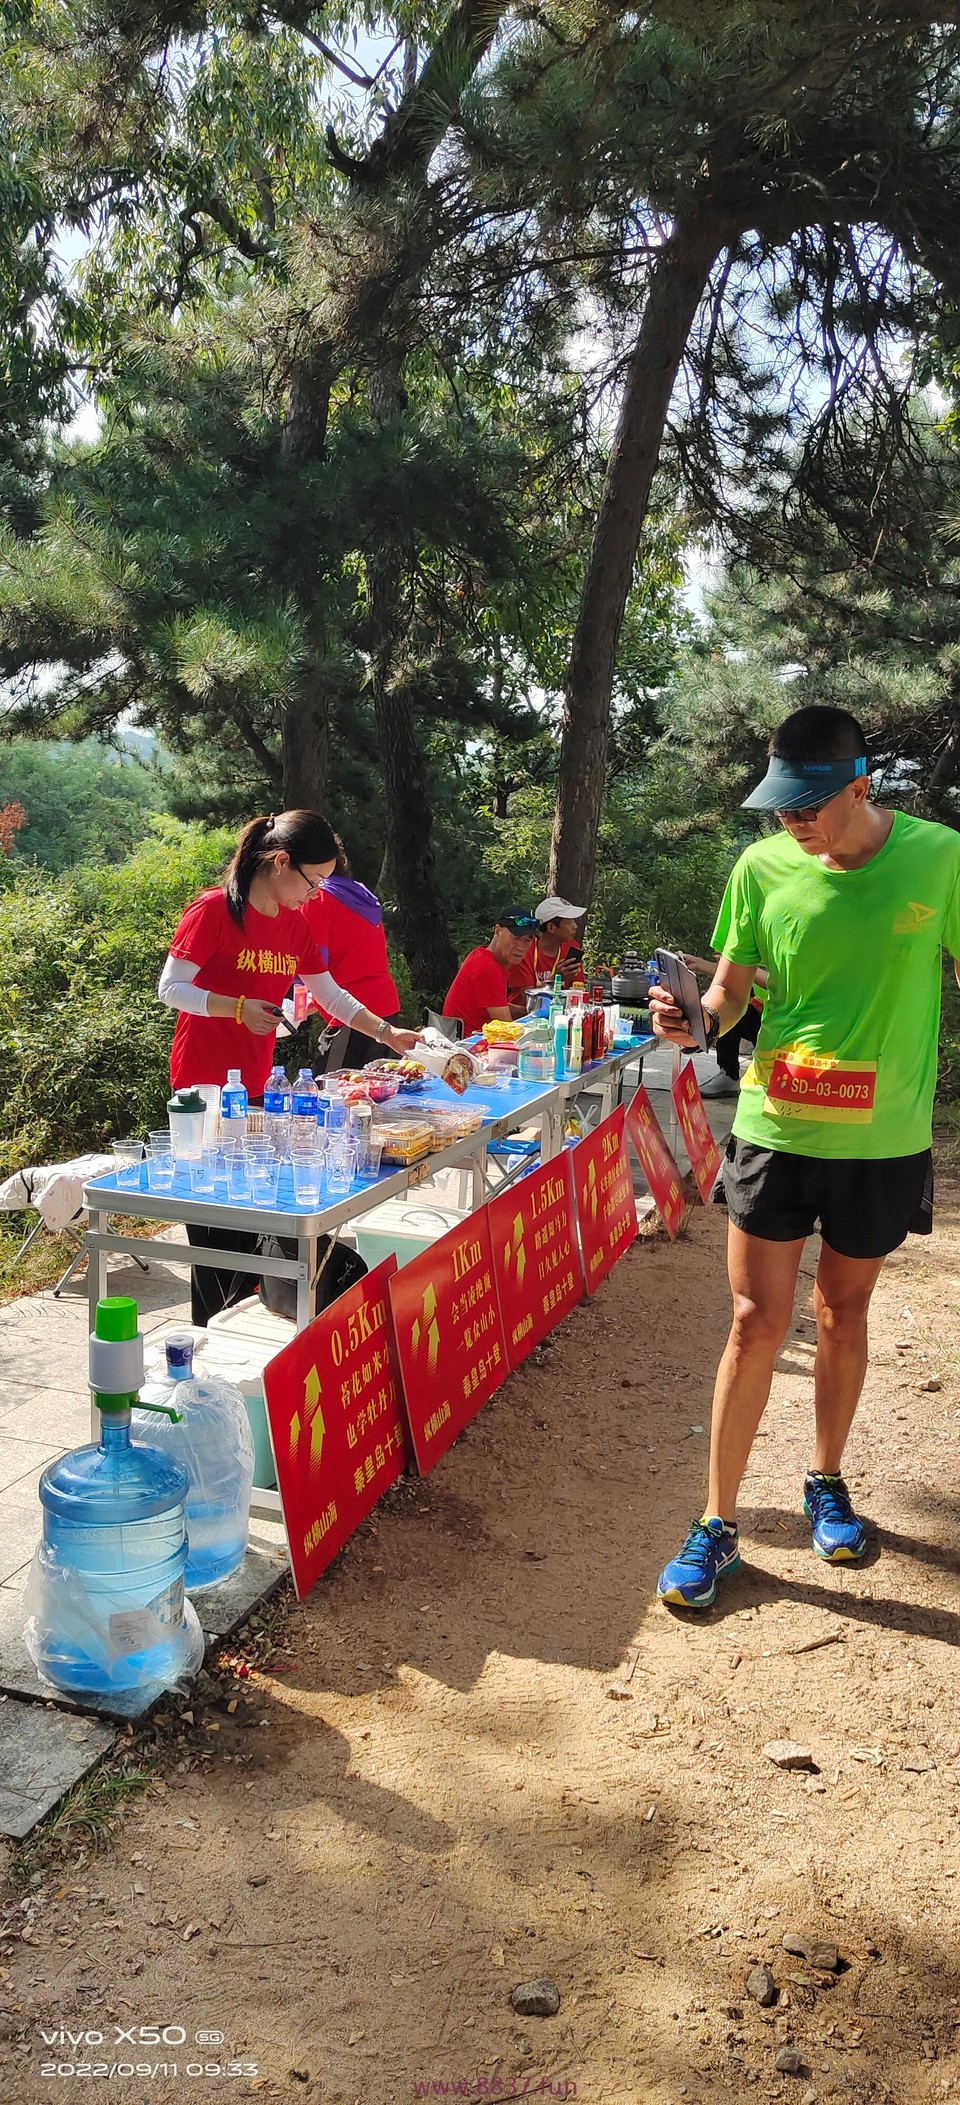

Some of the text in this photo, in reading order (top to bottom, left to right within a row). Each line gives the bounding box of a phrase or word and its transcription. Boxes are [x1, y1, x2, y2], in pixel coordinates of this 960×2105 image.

[236, 948, 297, 977] 纵横山海
[791, 1077, 869, 1099] SD-03-0073
[601, 1131, 620, 1162] 2Km
[530, 1176, 565, 1220] 1.5Km
[451, 1239, 483, 1283] 1Km
[538, 1240, 570, 1281] 日久见人心
[451, 1269, 492, 1325] 会当凌绝顶
[331, 1299, 388, 1367] 0.5Km
[456, 1304, 496, 1351] 一览众山小
[340, 1340, 392, 1410] 苔花如米小
[462, 1341, 501, 1399] 秦皇岛十登
[423, 1400, 451, 1442] 纵横山海
[353, 1421, 404, 1495] 秦皇岛十登
[303, 1500, 337, 1558] 纵横山海
